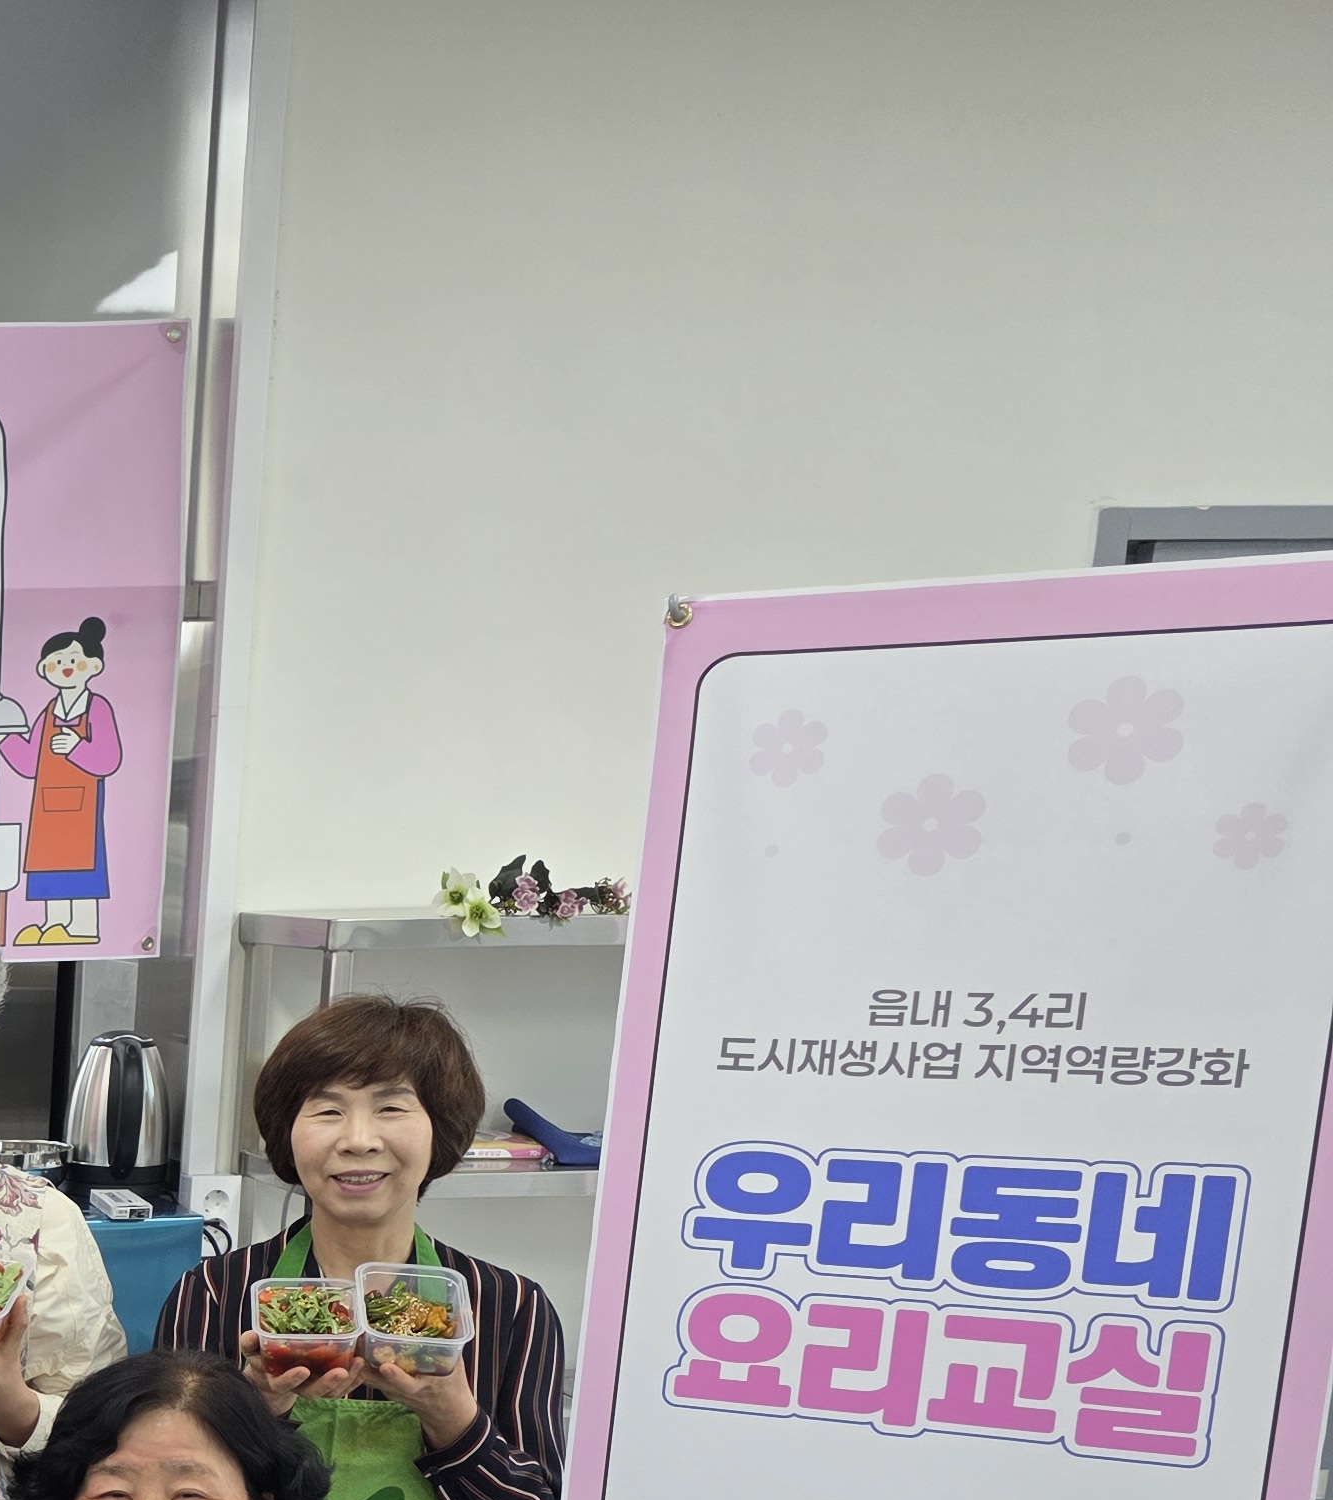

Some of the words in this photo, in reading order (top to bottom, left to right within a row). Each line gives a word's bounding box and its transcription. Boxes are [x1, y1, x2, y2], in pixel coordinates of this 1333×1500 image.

[716, 1036, 963, 1081] 도시재생사업
[973, 1043, 1251, 1088] 지역역량강화
[867, 988, 953, 1029] 읍내
[962, 990, 1088, 1035] 3,4리
[690, 1149, 1240, 1302] 우리동네
[671, 1292, 1214, 1459] 요리교실
